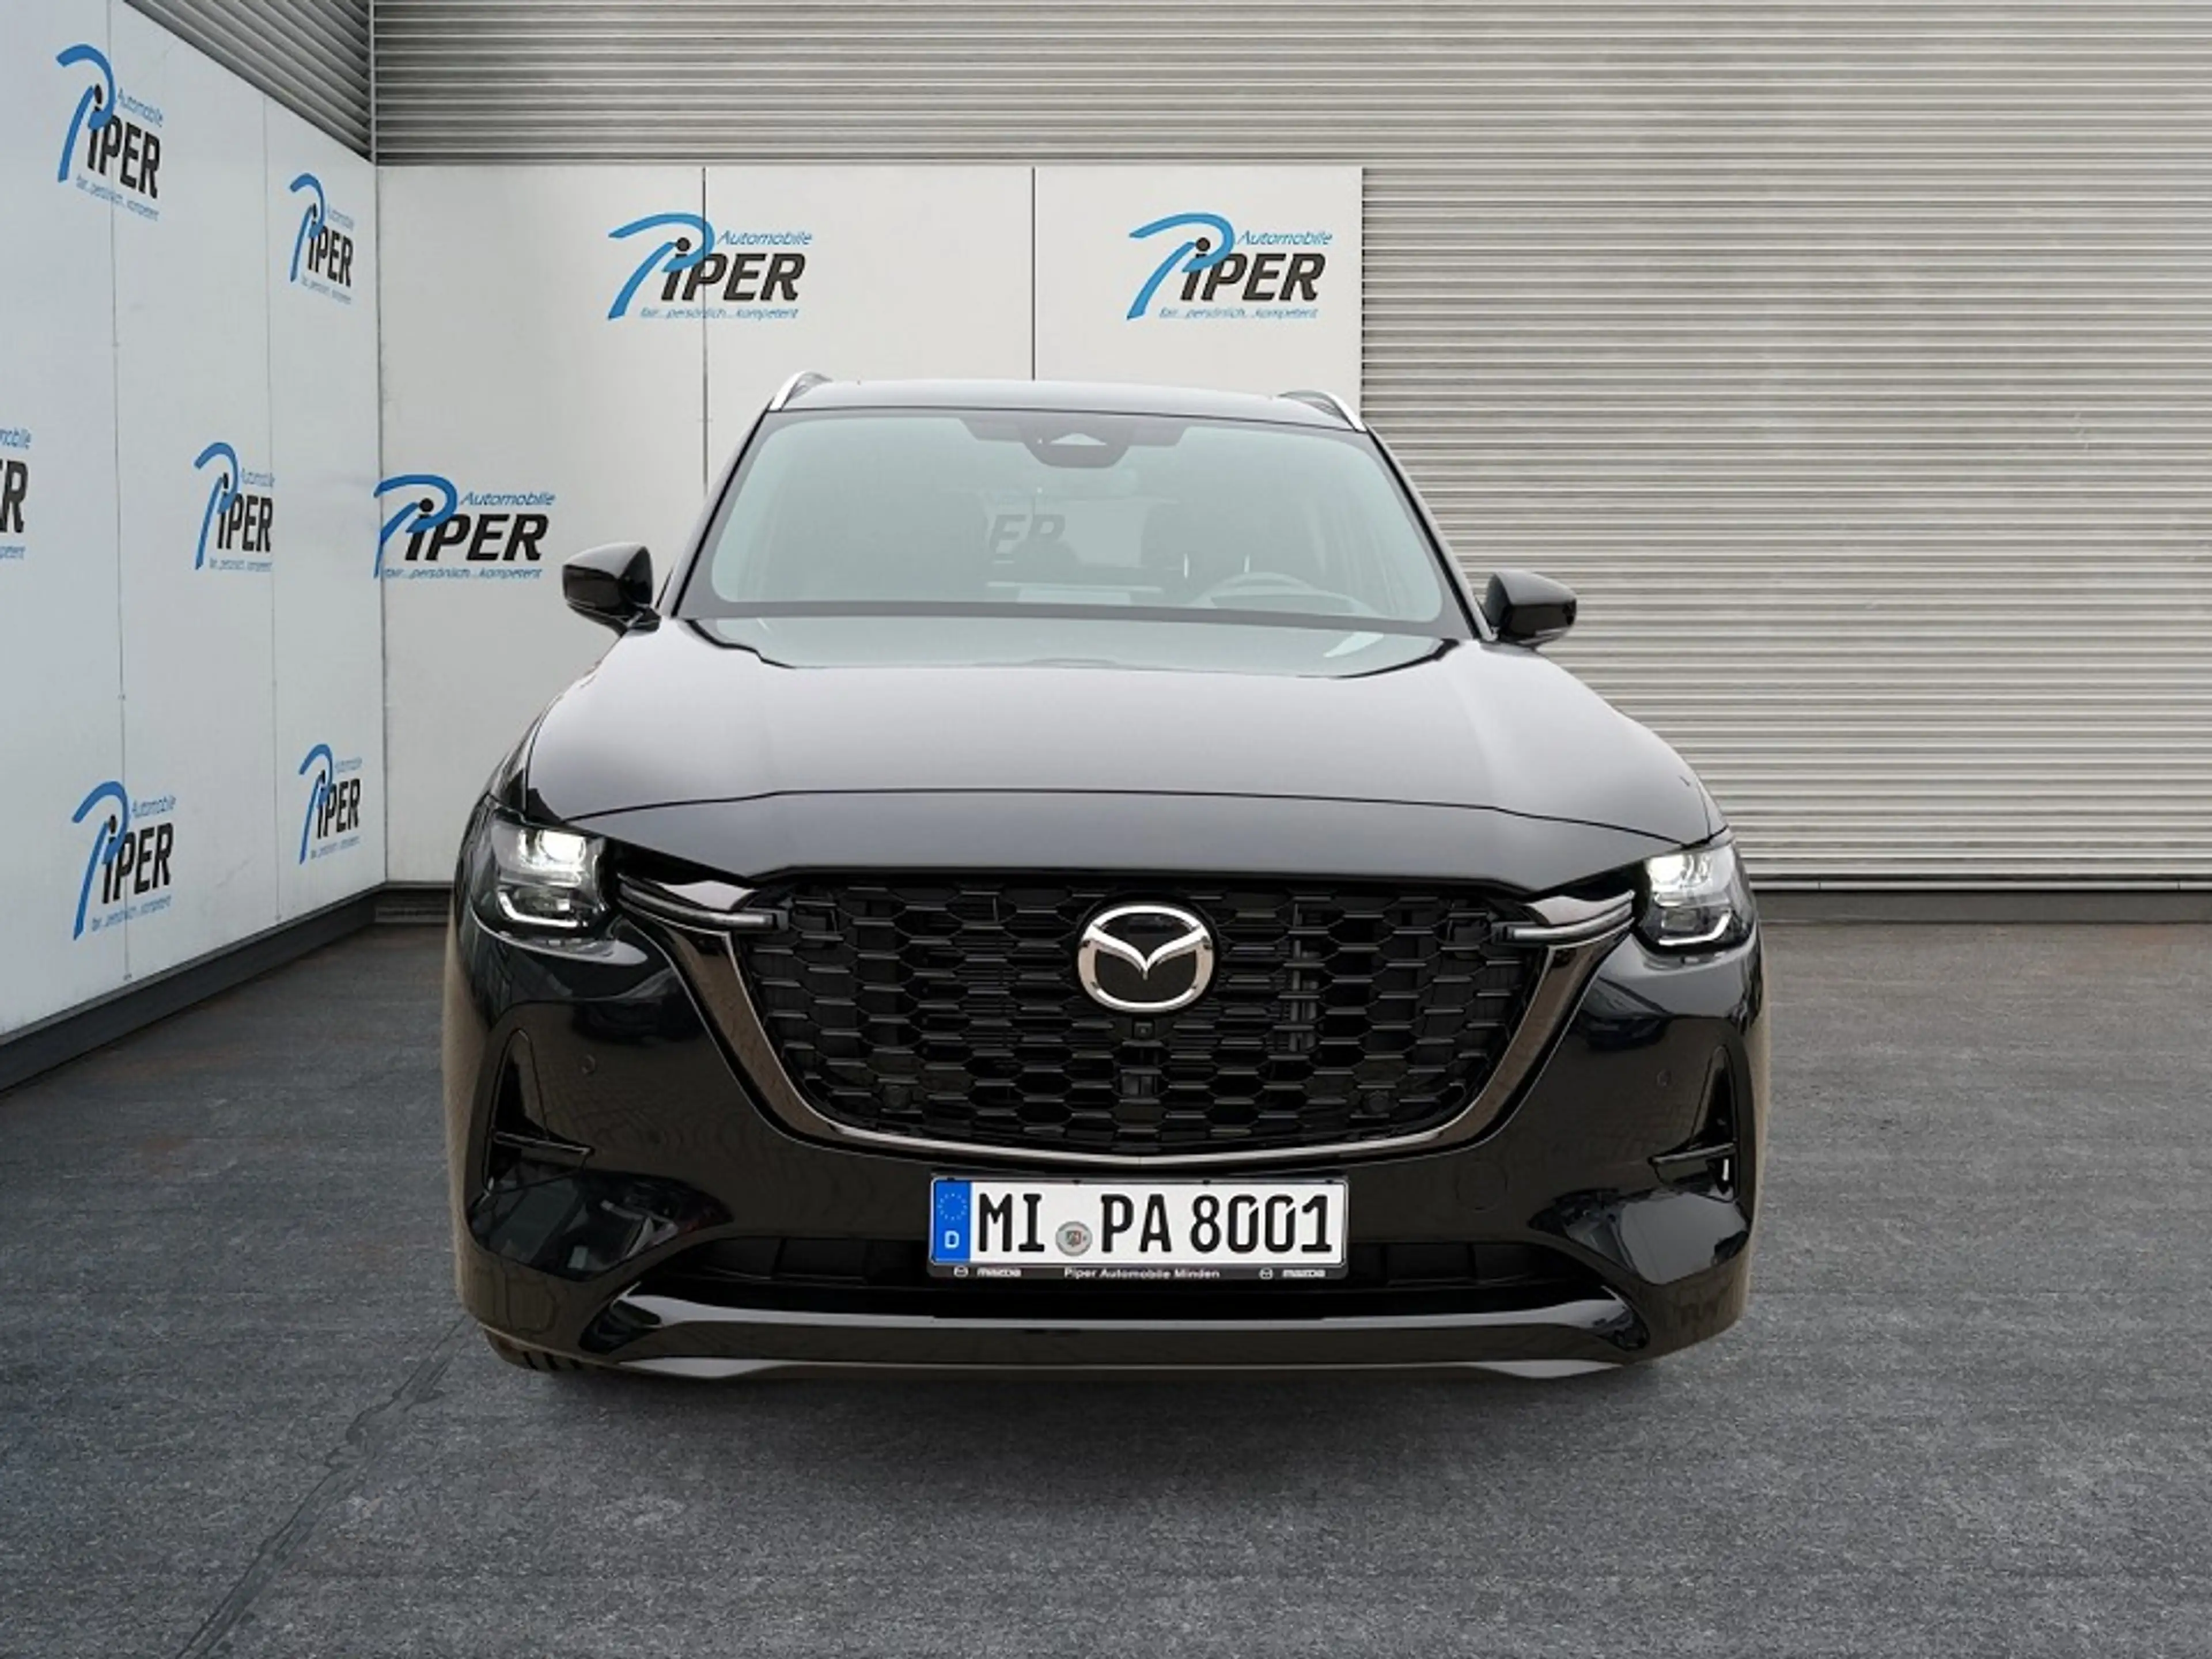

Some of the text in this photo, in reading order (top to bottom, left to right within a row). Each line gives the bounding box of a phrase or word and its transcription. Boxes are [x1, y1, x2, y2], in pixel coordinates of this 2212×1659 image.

[718, 230, 813, 246] Automobile
[1238, 230, 1334, 246] Automobile
[461, 492, 555, 506] Automobile
[979, 1193, 1332, 1253] MI PA 8001
[945, 1230, 960, 1249] D
[1064, 1267, 1221, 1280] Piper Automobile Minden
